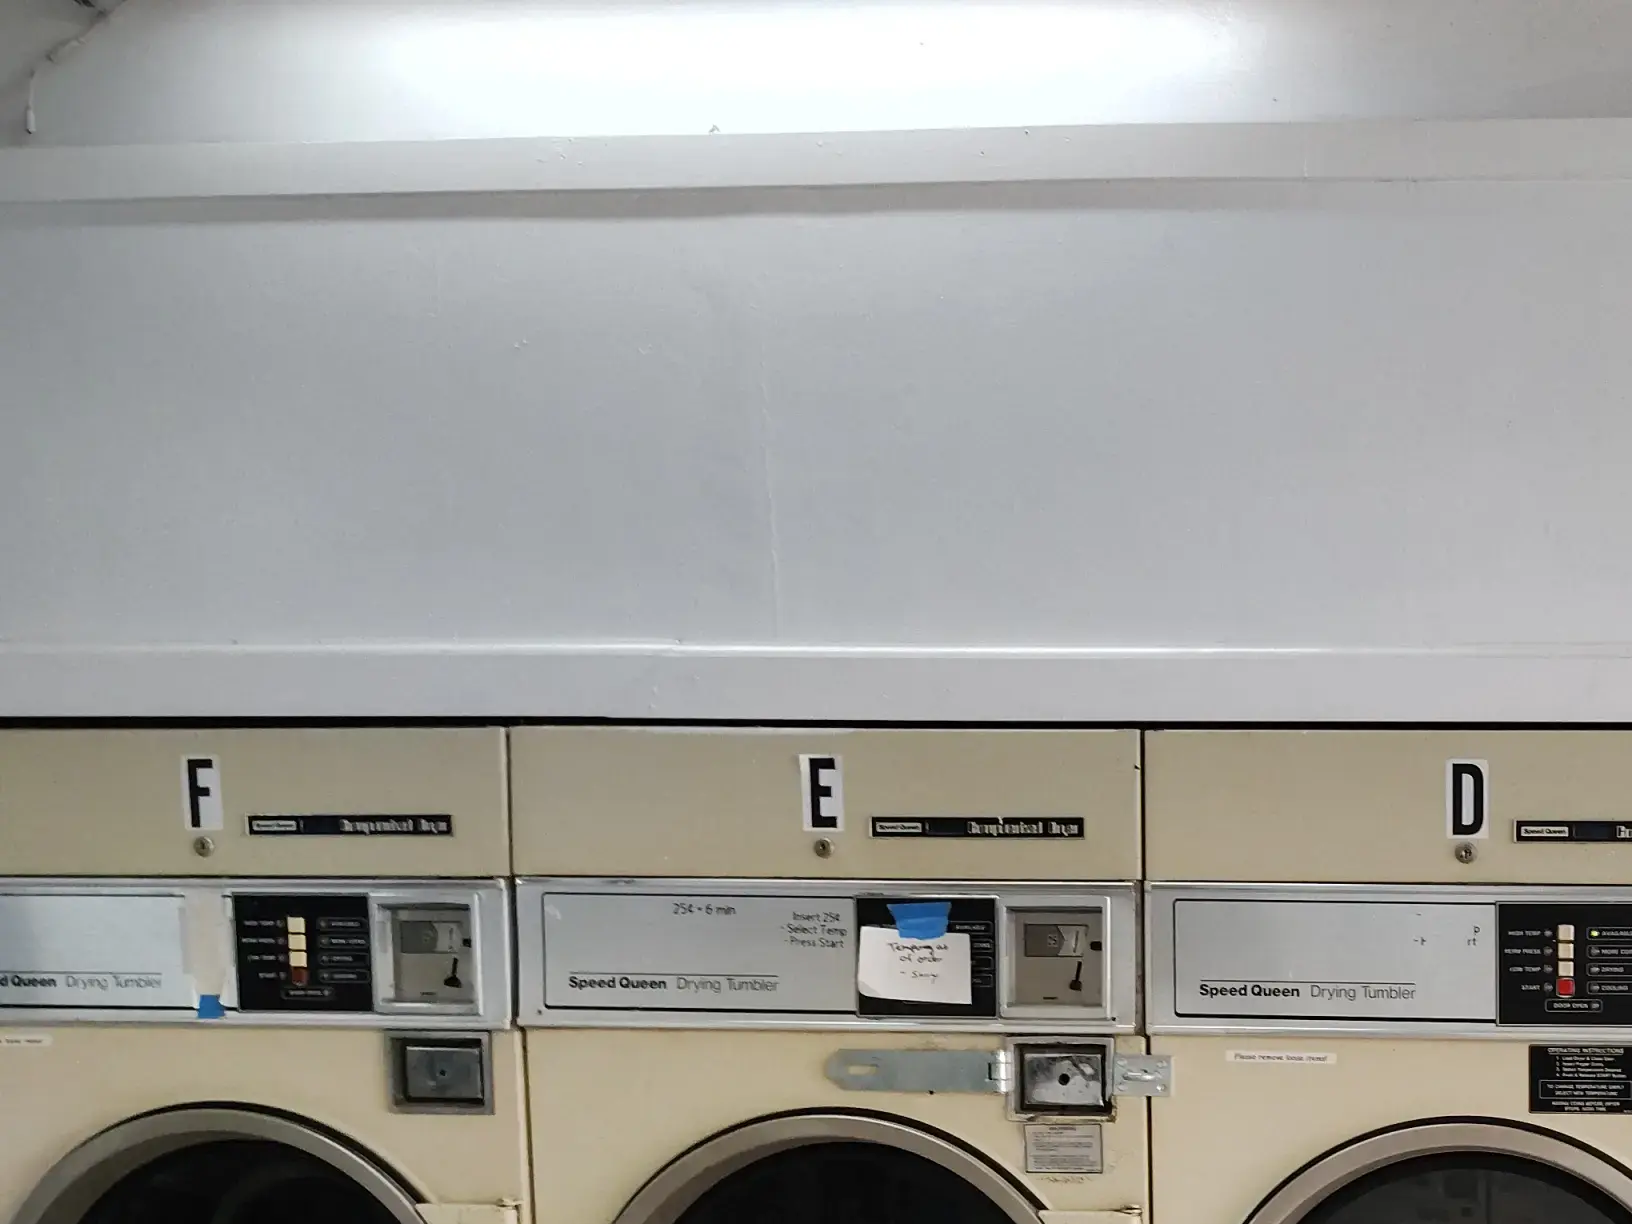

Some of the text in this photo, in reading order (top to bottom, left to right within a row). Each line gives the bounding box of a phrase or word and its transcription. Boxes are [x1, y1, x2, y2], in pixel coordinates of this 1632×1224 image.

[187, 758, 213, 827] F
[808, 758, 838, 828] E
[1452, 763, 1484, 836] D
[716, 903, 736, 915] min
[792, 912, 820, 921] Insert
[819, 937, 844, 948] Start
[11, 975, 57, 988] Queen
[568, 976, 779, 993] Speed Queen Drying Tumbler
[1199, 984, 1416, 1001] Speed Queen Drying Tumbler
